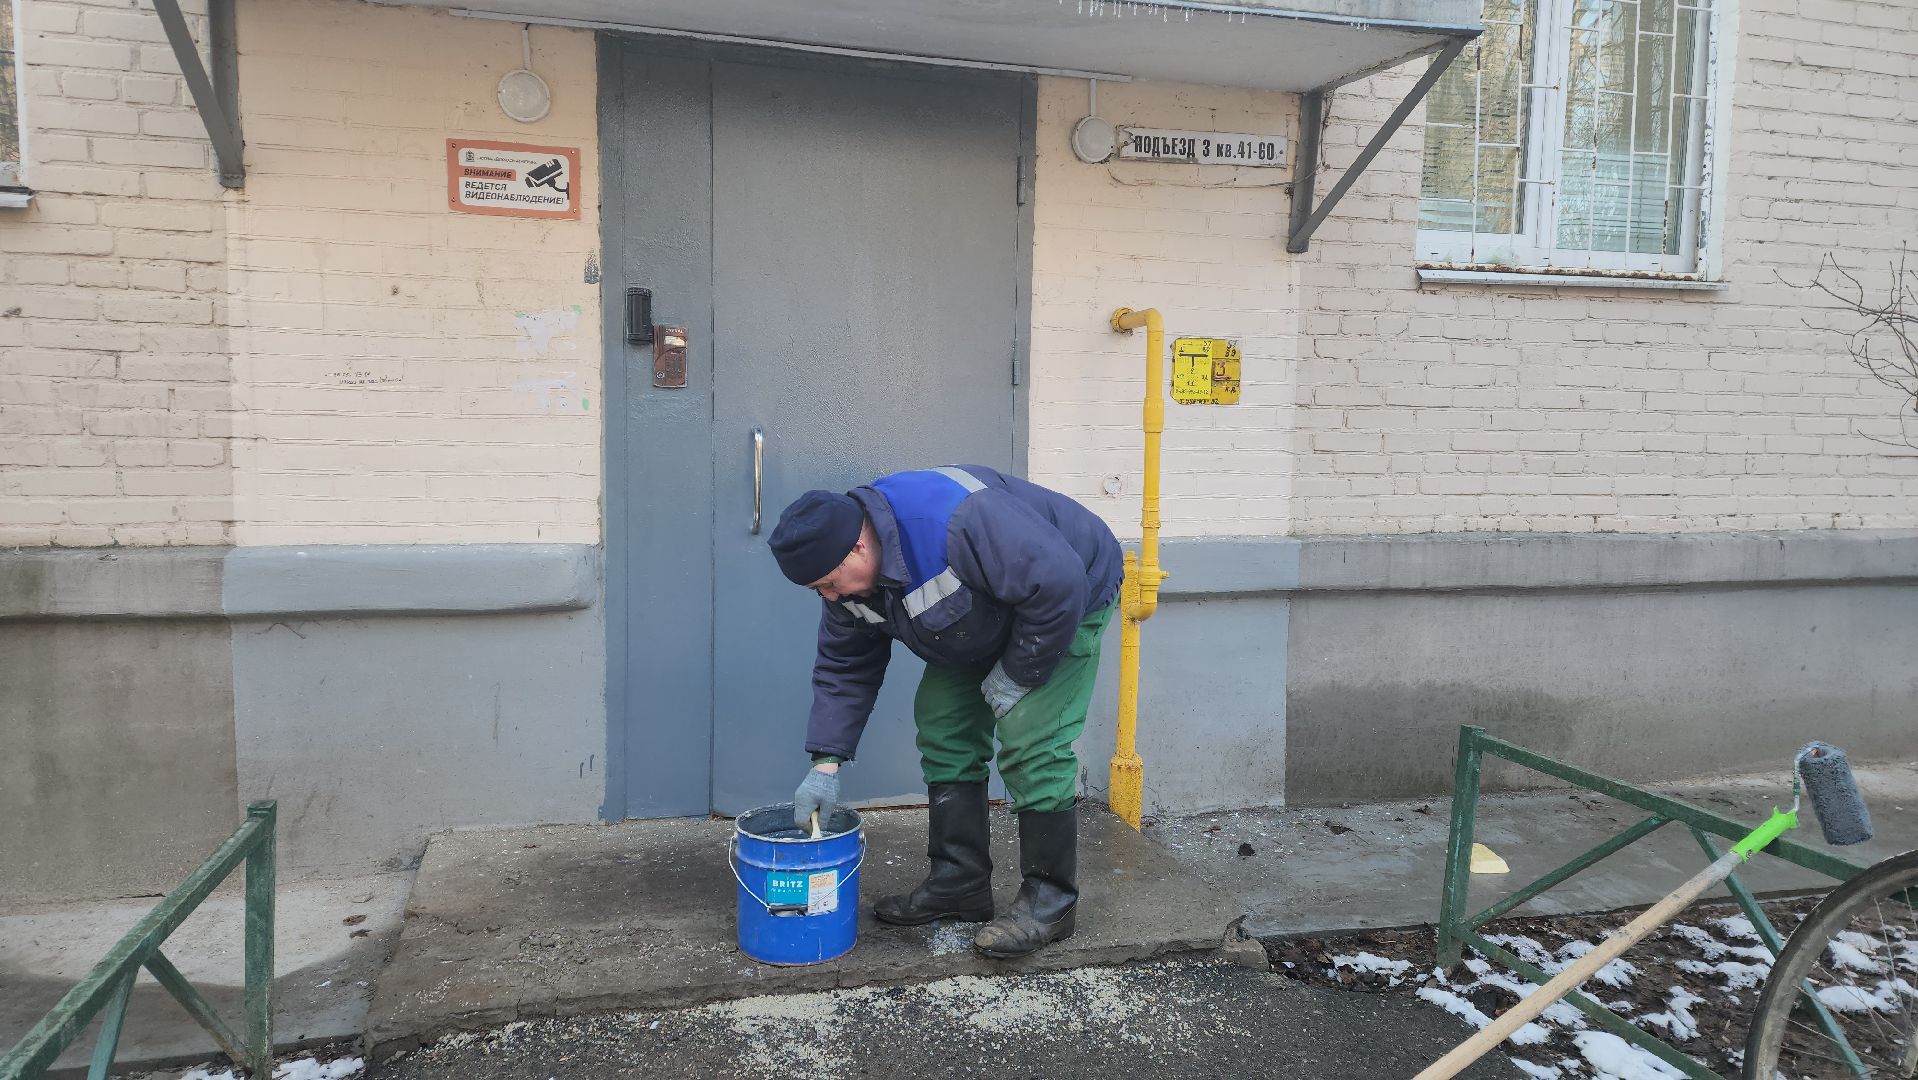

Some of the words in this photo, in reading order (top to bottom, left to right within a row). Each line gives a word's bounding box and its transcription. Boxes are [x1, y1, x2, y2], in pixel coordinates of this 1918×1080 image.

[1134, 135, 1196, 158] ПОДЪЕЗД
[1202, 139, 1211, 157] 3
[464, 168, 512, 179] ВНИМАНИЕ
[465, 181, 507, 191] ВЕДЕТСЯ
[465, 191, 564, 205] ВИДЕОНАБЛЮДЕНИЕ!
[772, 879, 804, 888] BRITZ
